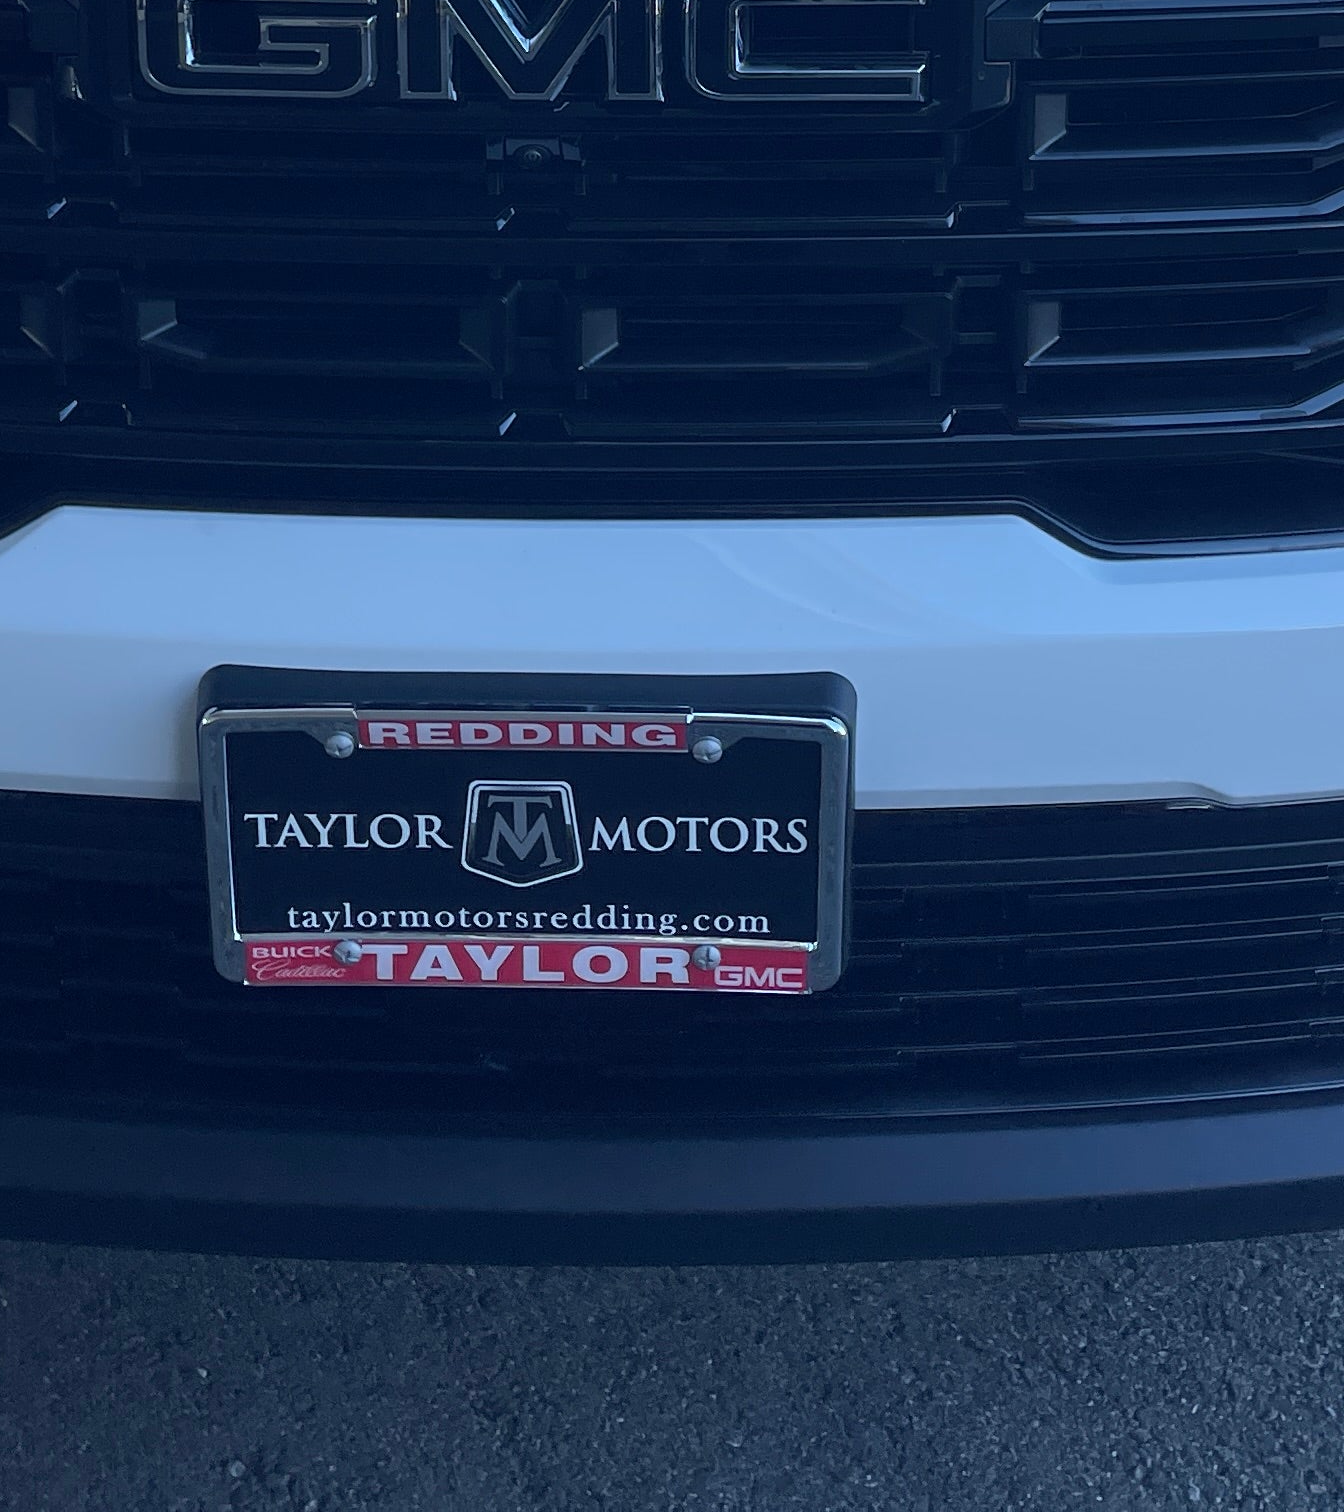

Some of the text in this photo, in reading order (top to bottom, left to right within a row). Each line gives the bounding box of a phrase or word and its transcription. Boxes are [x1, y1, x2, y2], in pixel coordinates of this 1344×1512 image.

[367, 721, 677, 747] REDDING
[243, 812, 454, 849] TAYLOR
[587, 815, 808, 854] MOTORS
[287, 902, 771, 935] taylormotorsredding.com
[251, 944, 333, 959] BUICK
[360, 944, 690, 985] TAYLOR
[251, 958, 347, 982] Cadillac
[713, 964, 803, 988] GMC
